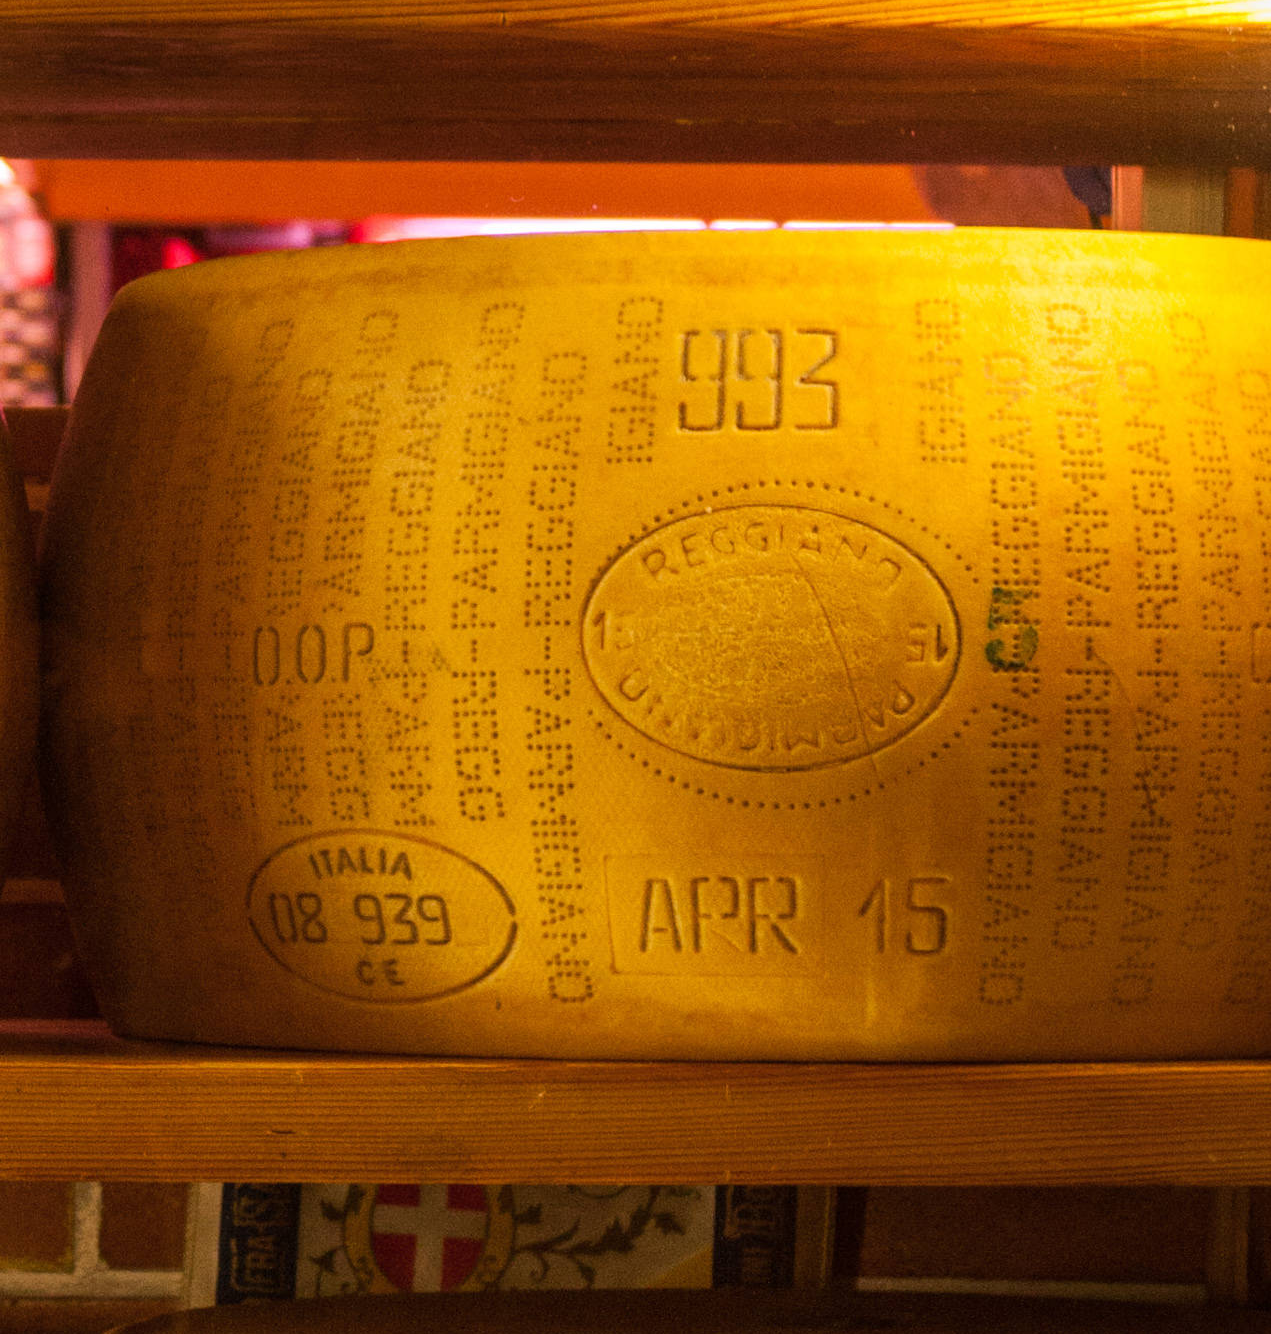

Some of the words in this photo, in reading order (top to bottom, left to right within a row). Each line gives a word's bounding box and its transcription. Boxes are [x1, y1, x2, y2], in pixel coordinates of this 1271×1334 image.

[678, 327, 840, 432] 993
[308, 847, 414, 881] ITALIA
[268, 892, 328, 944] 08
[353, 892, 454, 947] 939
[640, 874, 800, 955] APR
[860, 874, 951, 956] 15
